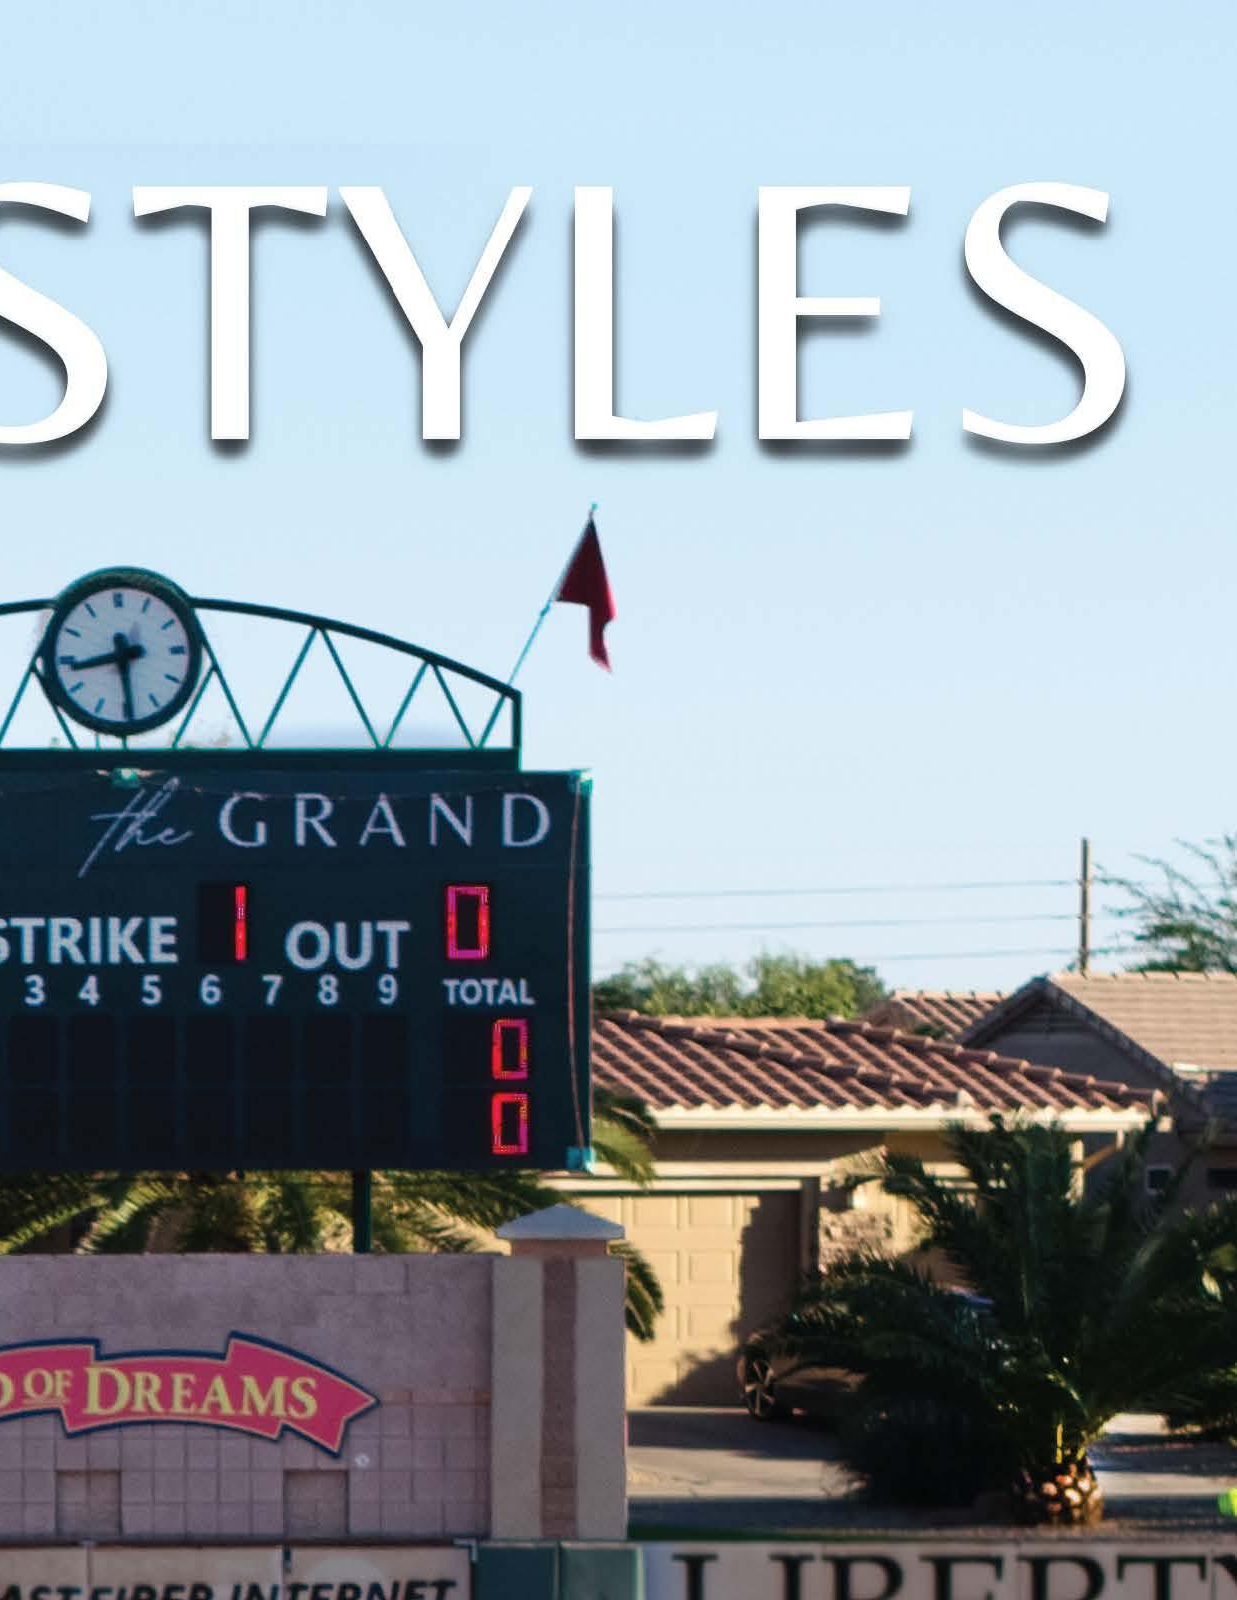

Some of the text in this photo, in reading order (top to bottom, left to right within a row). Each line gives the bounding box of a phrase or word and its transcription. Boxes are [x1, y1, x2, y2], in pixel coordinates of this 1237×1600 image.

[77, 776, 551, 878] the GRAND
[235, 886, 247, 961] 1
[285, 920, 411, 970] OUT
[447, 886, 490, 960] 0
[24, 975, 45, 1005] 3
[78, 975, 100, 1005] 4
[142, 975, 161, 1005] 5
[201, 974, 221, 1005] 6
[263, 974, 283, 1005] 7
[318, 974, 339, 1005] 8
[378, 974, 398, 1005] 9
[443, 979, 535, 1005] TOTAL
[491, 1019, 528, 1080] 0
[491, 1092, 529, 1155] 0
[23, 1367, 73, 1402] OF
[83, 1366, 319, 1419] DREAMS
